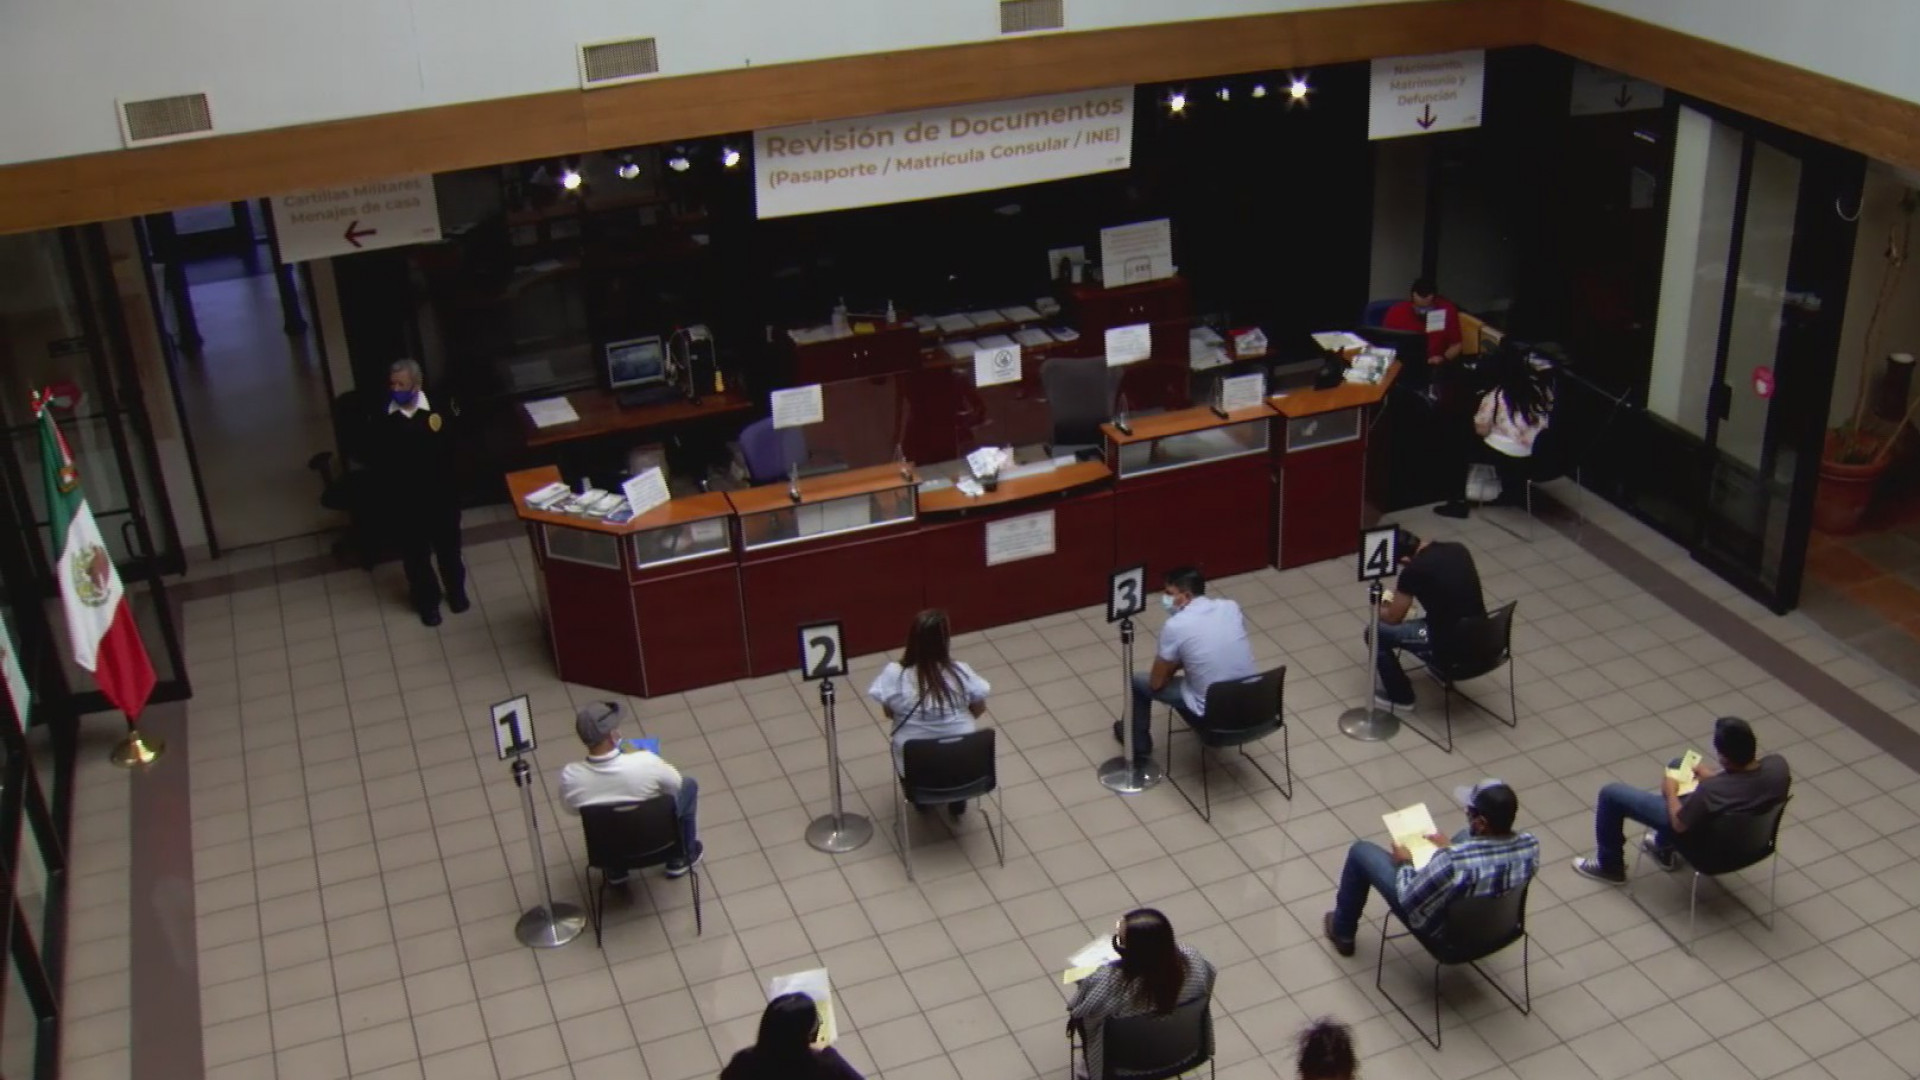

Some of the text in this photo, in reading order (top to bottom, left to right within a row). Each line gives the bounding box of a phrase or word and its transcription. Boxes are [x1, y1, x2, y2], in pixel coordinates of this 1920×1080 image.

[1390, 75, 1467, 91] Matrimonio y
[766, 98, 1124, 158] Revisión de Documentos
[769, 126, 1121, 189] (Pasaporte / Matrícula Consular / INE)
[284, 177, 423, 208] Cartillas Militares
[291, 195, 421, 225] Menajes de casa
[1367, 538, 1389, 577] 4
[1117, 578, 1137, 618] 3
[810, 636, 836, 676] 2
[499, 709, 531, 756] 1
